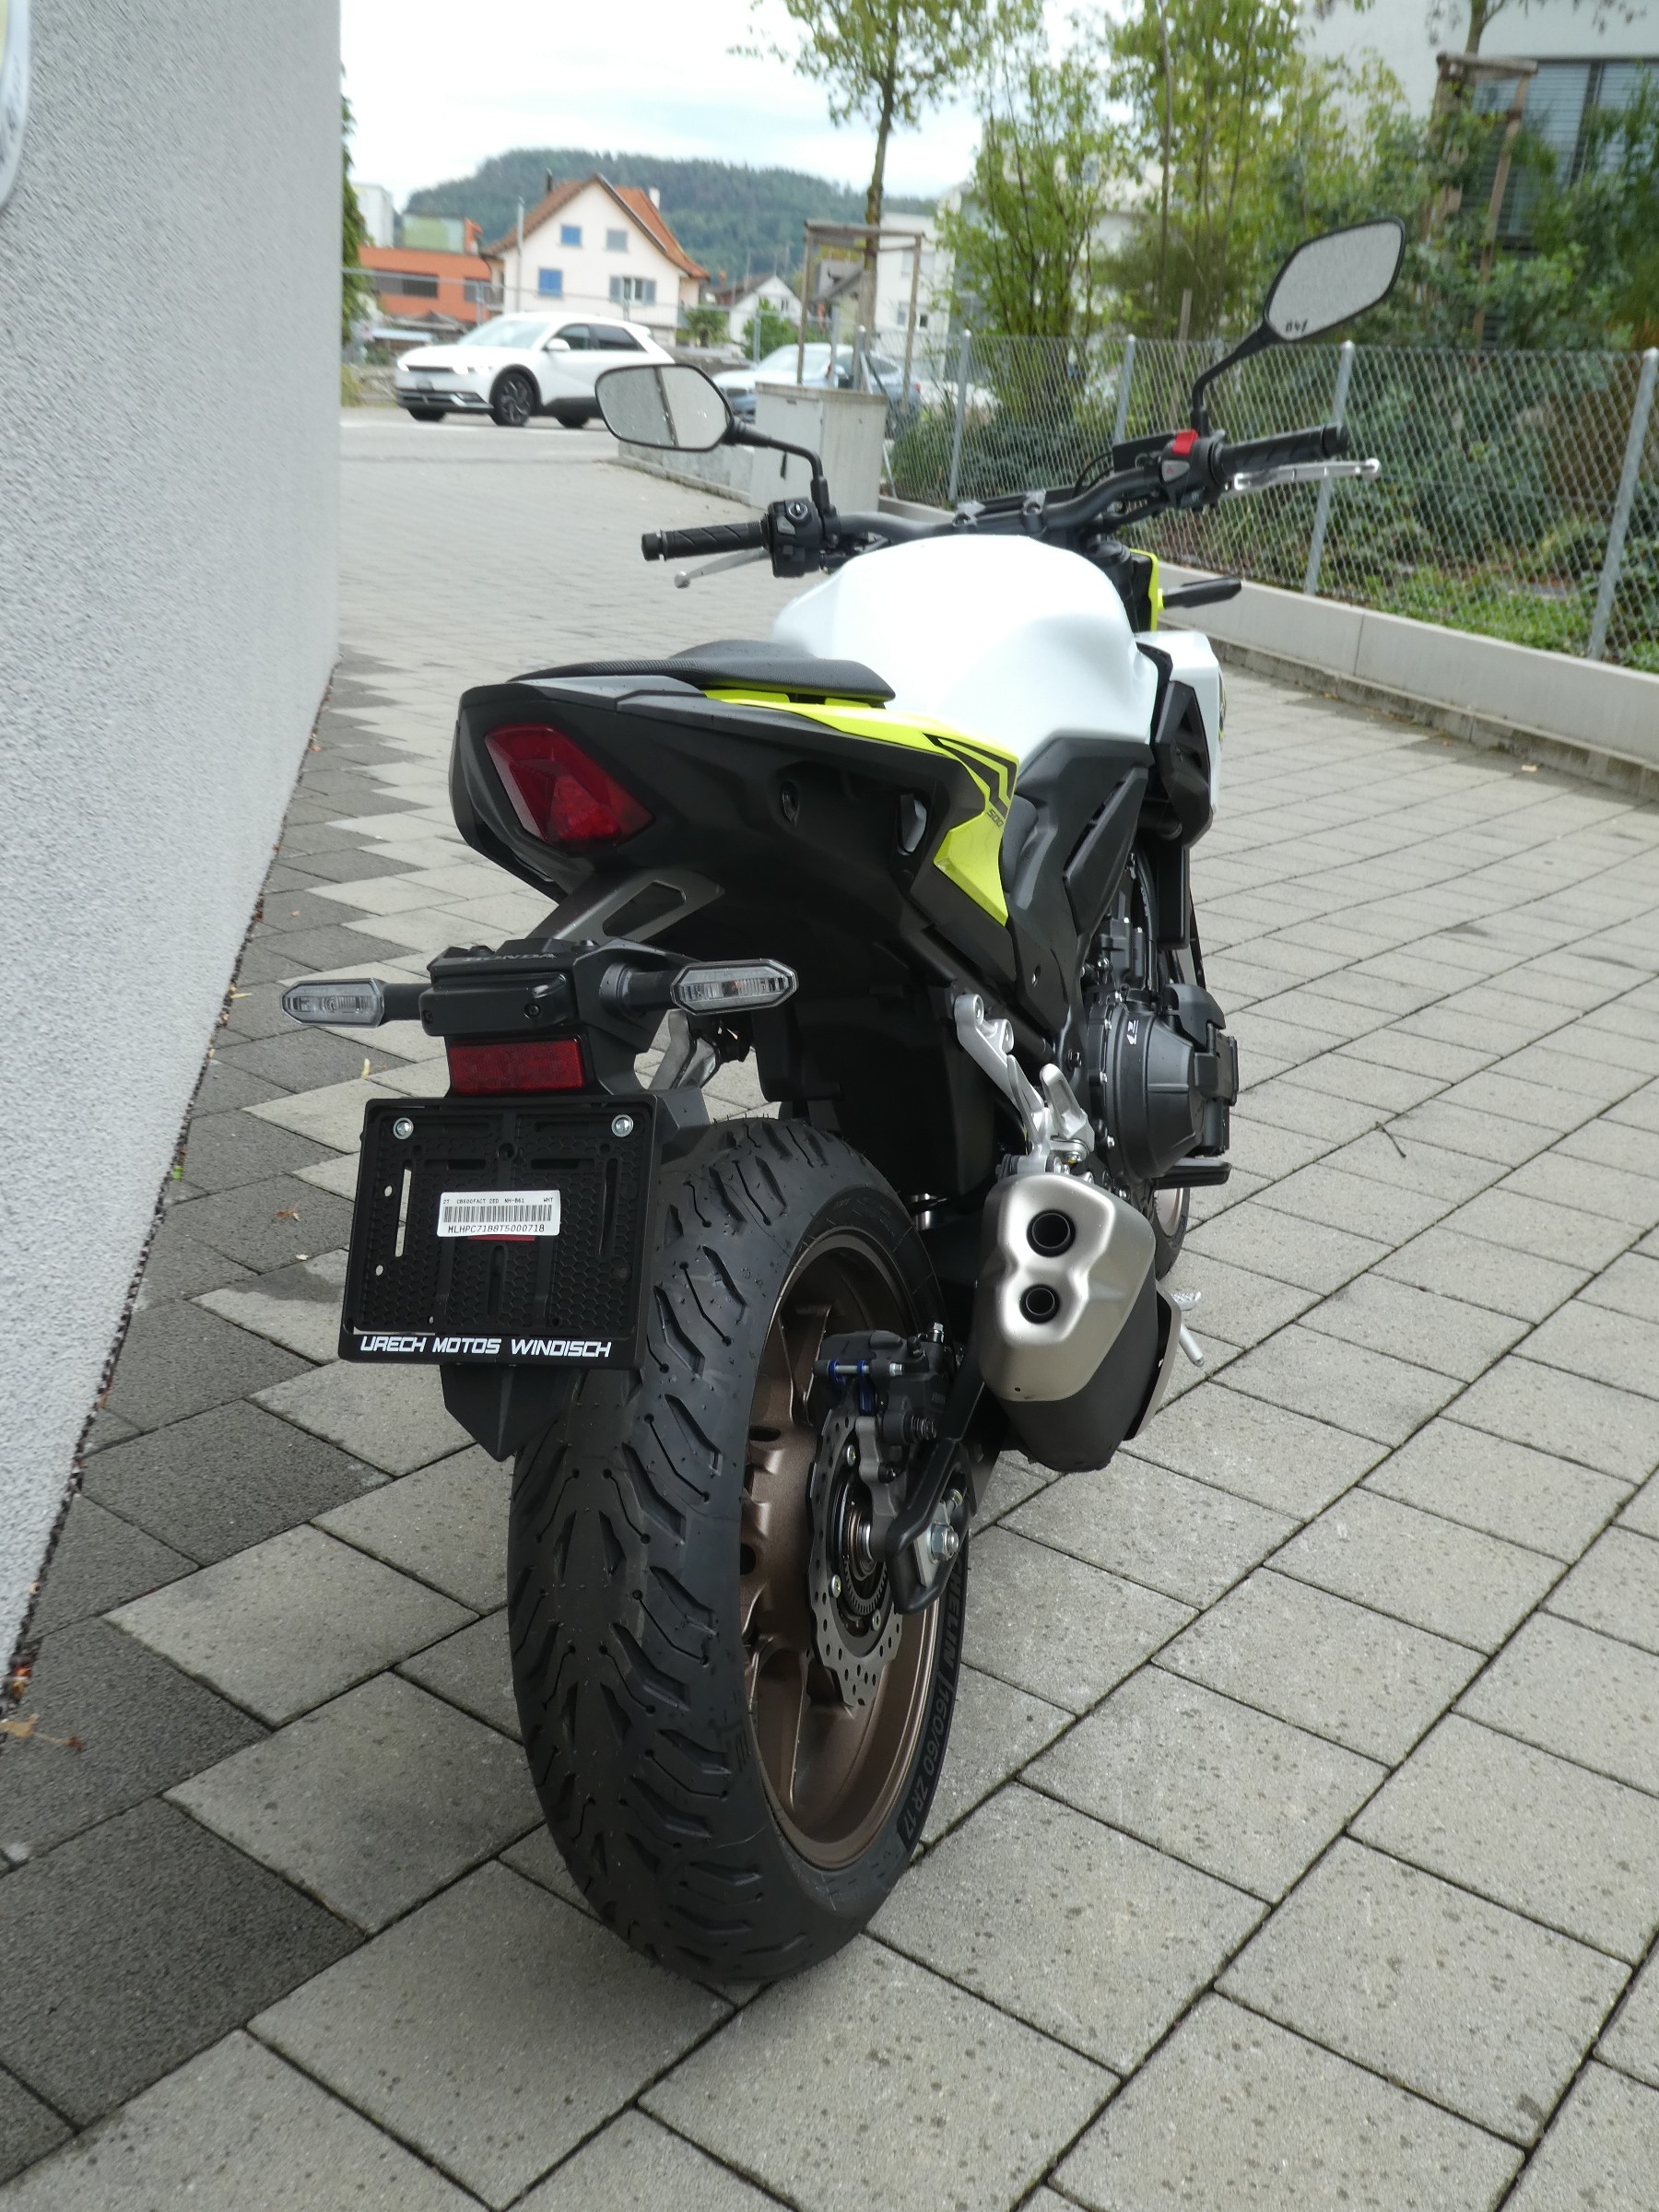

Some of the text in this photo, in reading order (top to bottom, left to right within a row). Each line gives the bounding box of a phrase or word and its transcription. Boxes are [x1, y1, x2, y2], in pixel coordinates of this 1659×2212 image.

[987, 809, 1004, 827] 500
[361, 1336, 612, 1358] URECH MOTOS WINDISCH
[923, 1685, 949, 1776] 160/60
